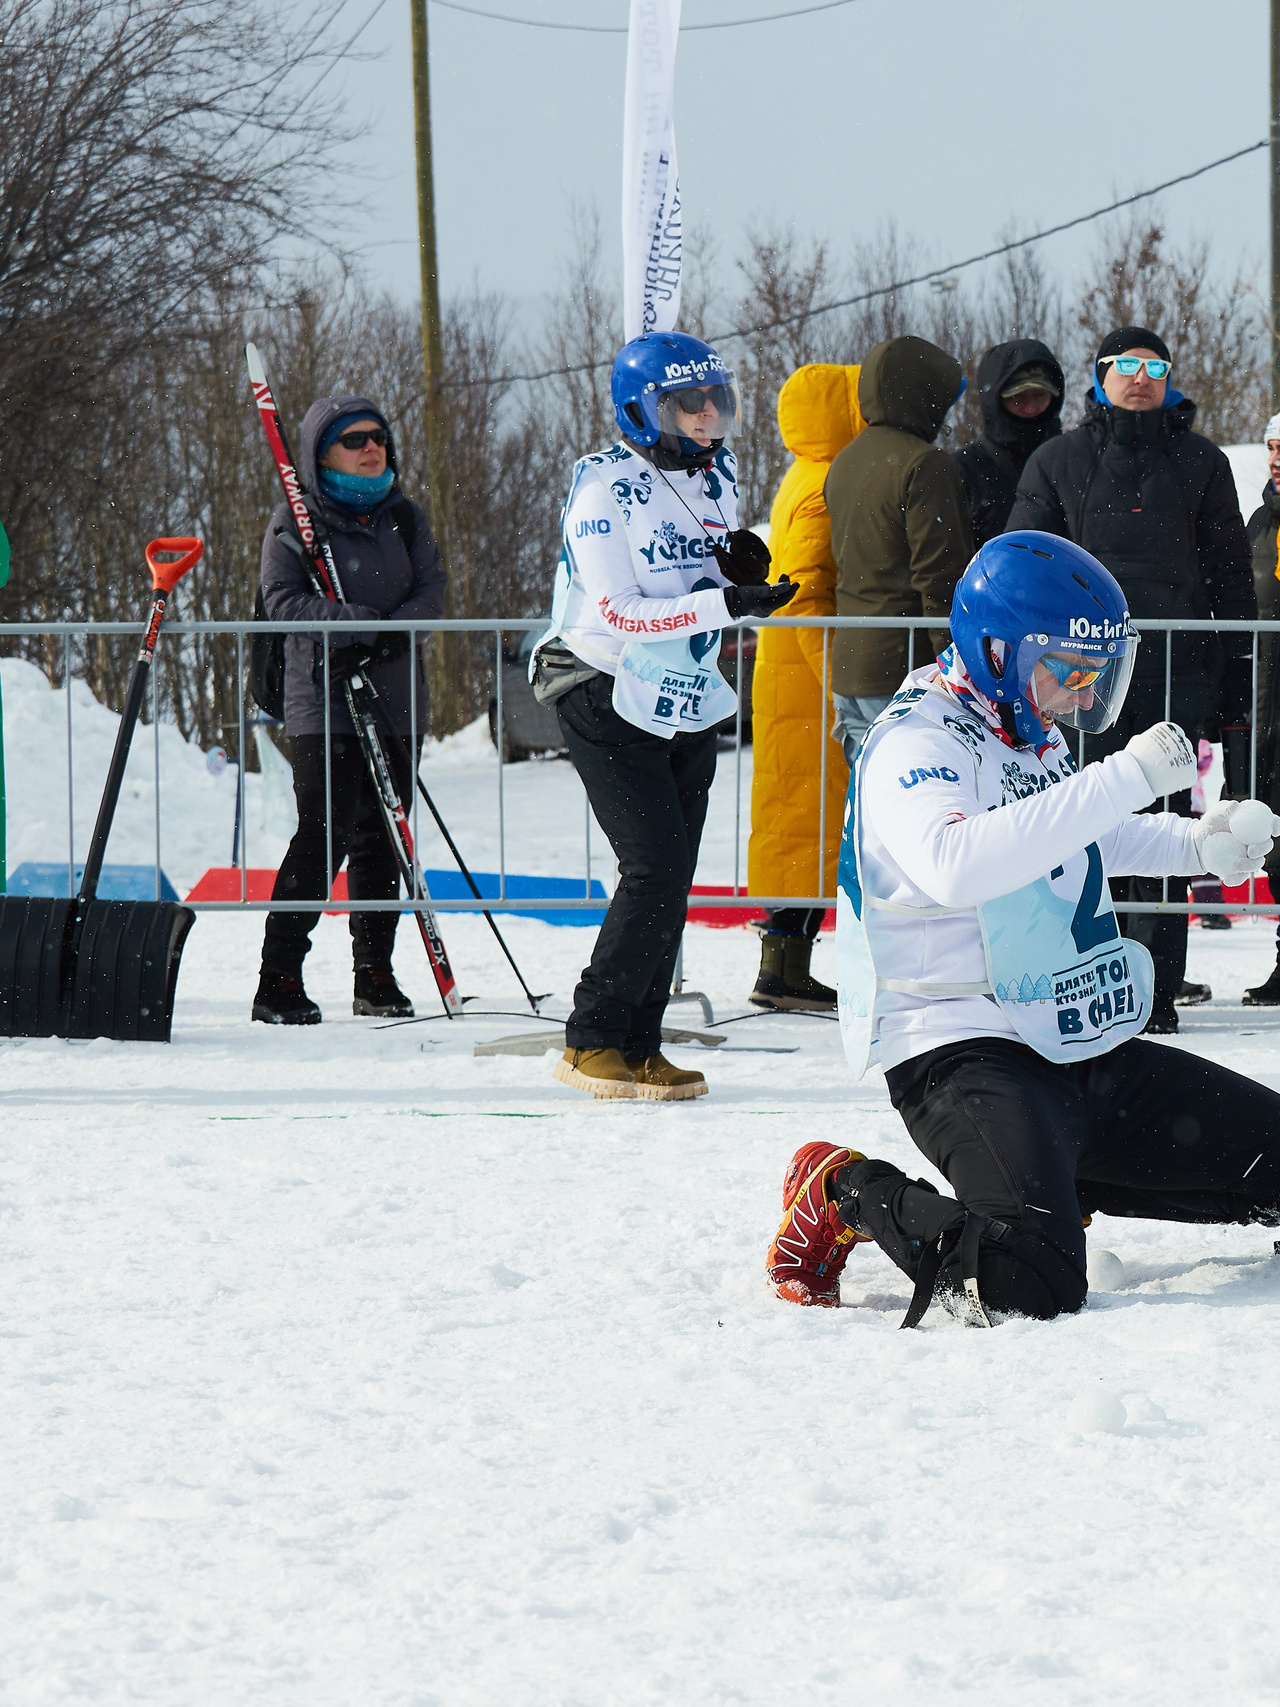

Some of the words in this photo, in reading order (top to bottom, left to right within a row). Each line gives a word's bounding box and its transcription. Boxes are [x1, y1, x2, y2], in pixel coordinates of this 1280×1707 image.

[575, 519, 611, 539] UNO
[1060, 641, 1103, 651] МУРМАНСК
[660, 686, 678, 696] КТО
[662, 676, 686, 689] ДЛЯ
[654, 696, 675, 718] В
[898, 766, 960, 789] UNO
[1054, 977, 1081, 996] ДЛЯ
[1055, 993, 1078, 1006] КТО
[1057, 1008, 1084, 1036] В
